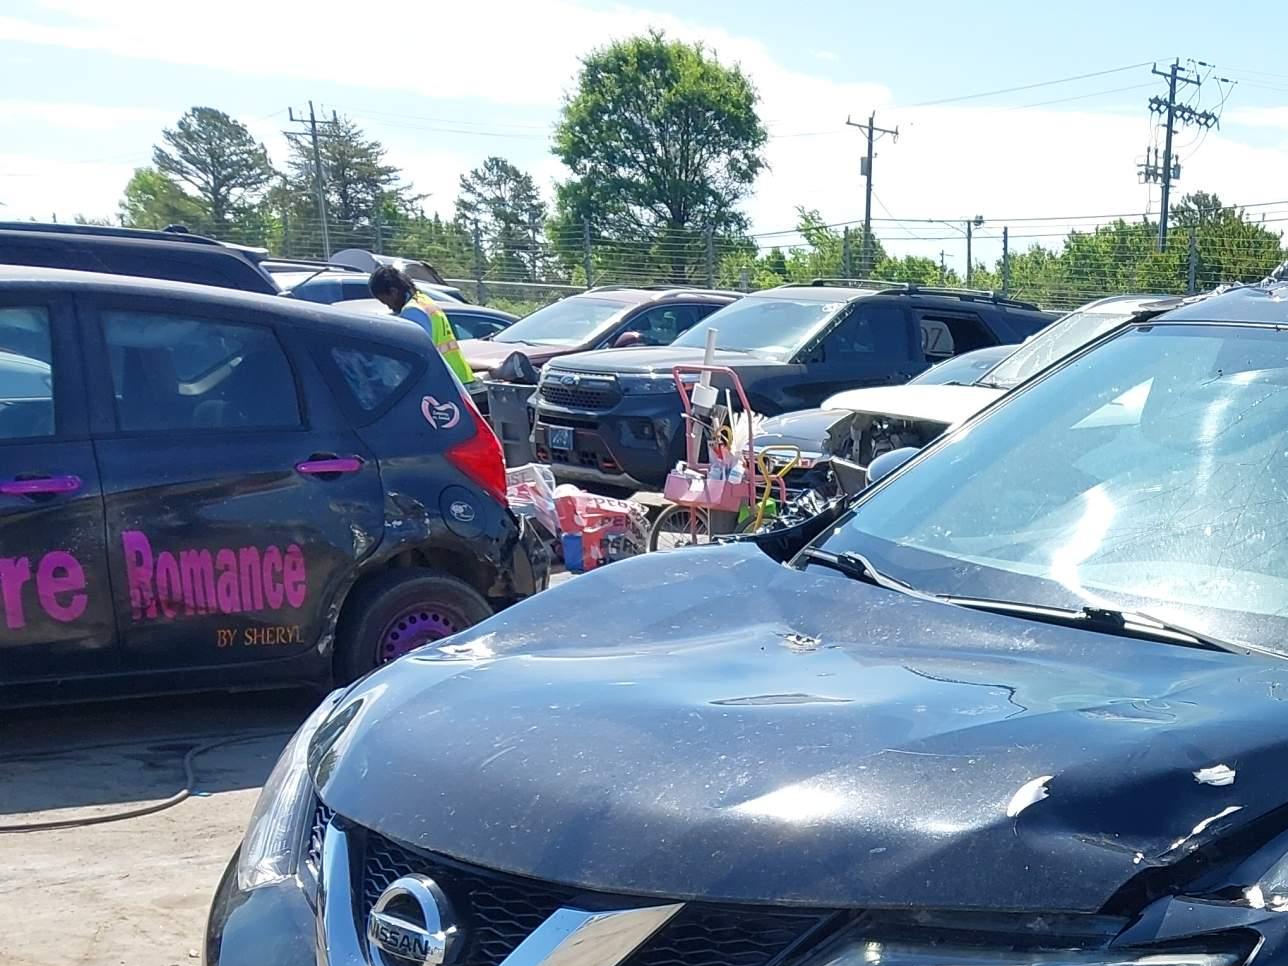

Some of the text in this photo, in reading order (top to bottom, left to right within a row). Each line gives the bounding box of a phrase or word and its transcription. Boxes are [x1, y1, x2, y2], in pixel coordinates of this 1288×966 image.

[121, 530, 306, 620] Romance
[217, 625, 304, 647] BY SHERYL
[369, 917, 430, 956] NISSAN
